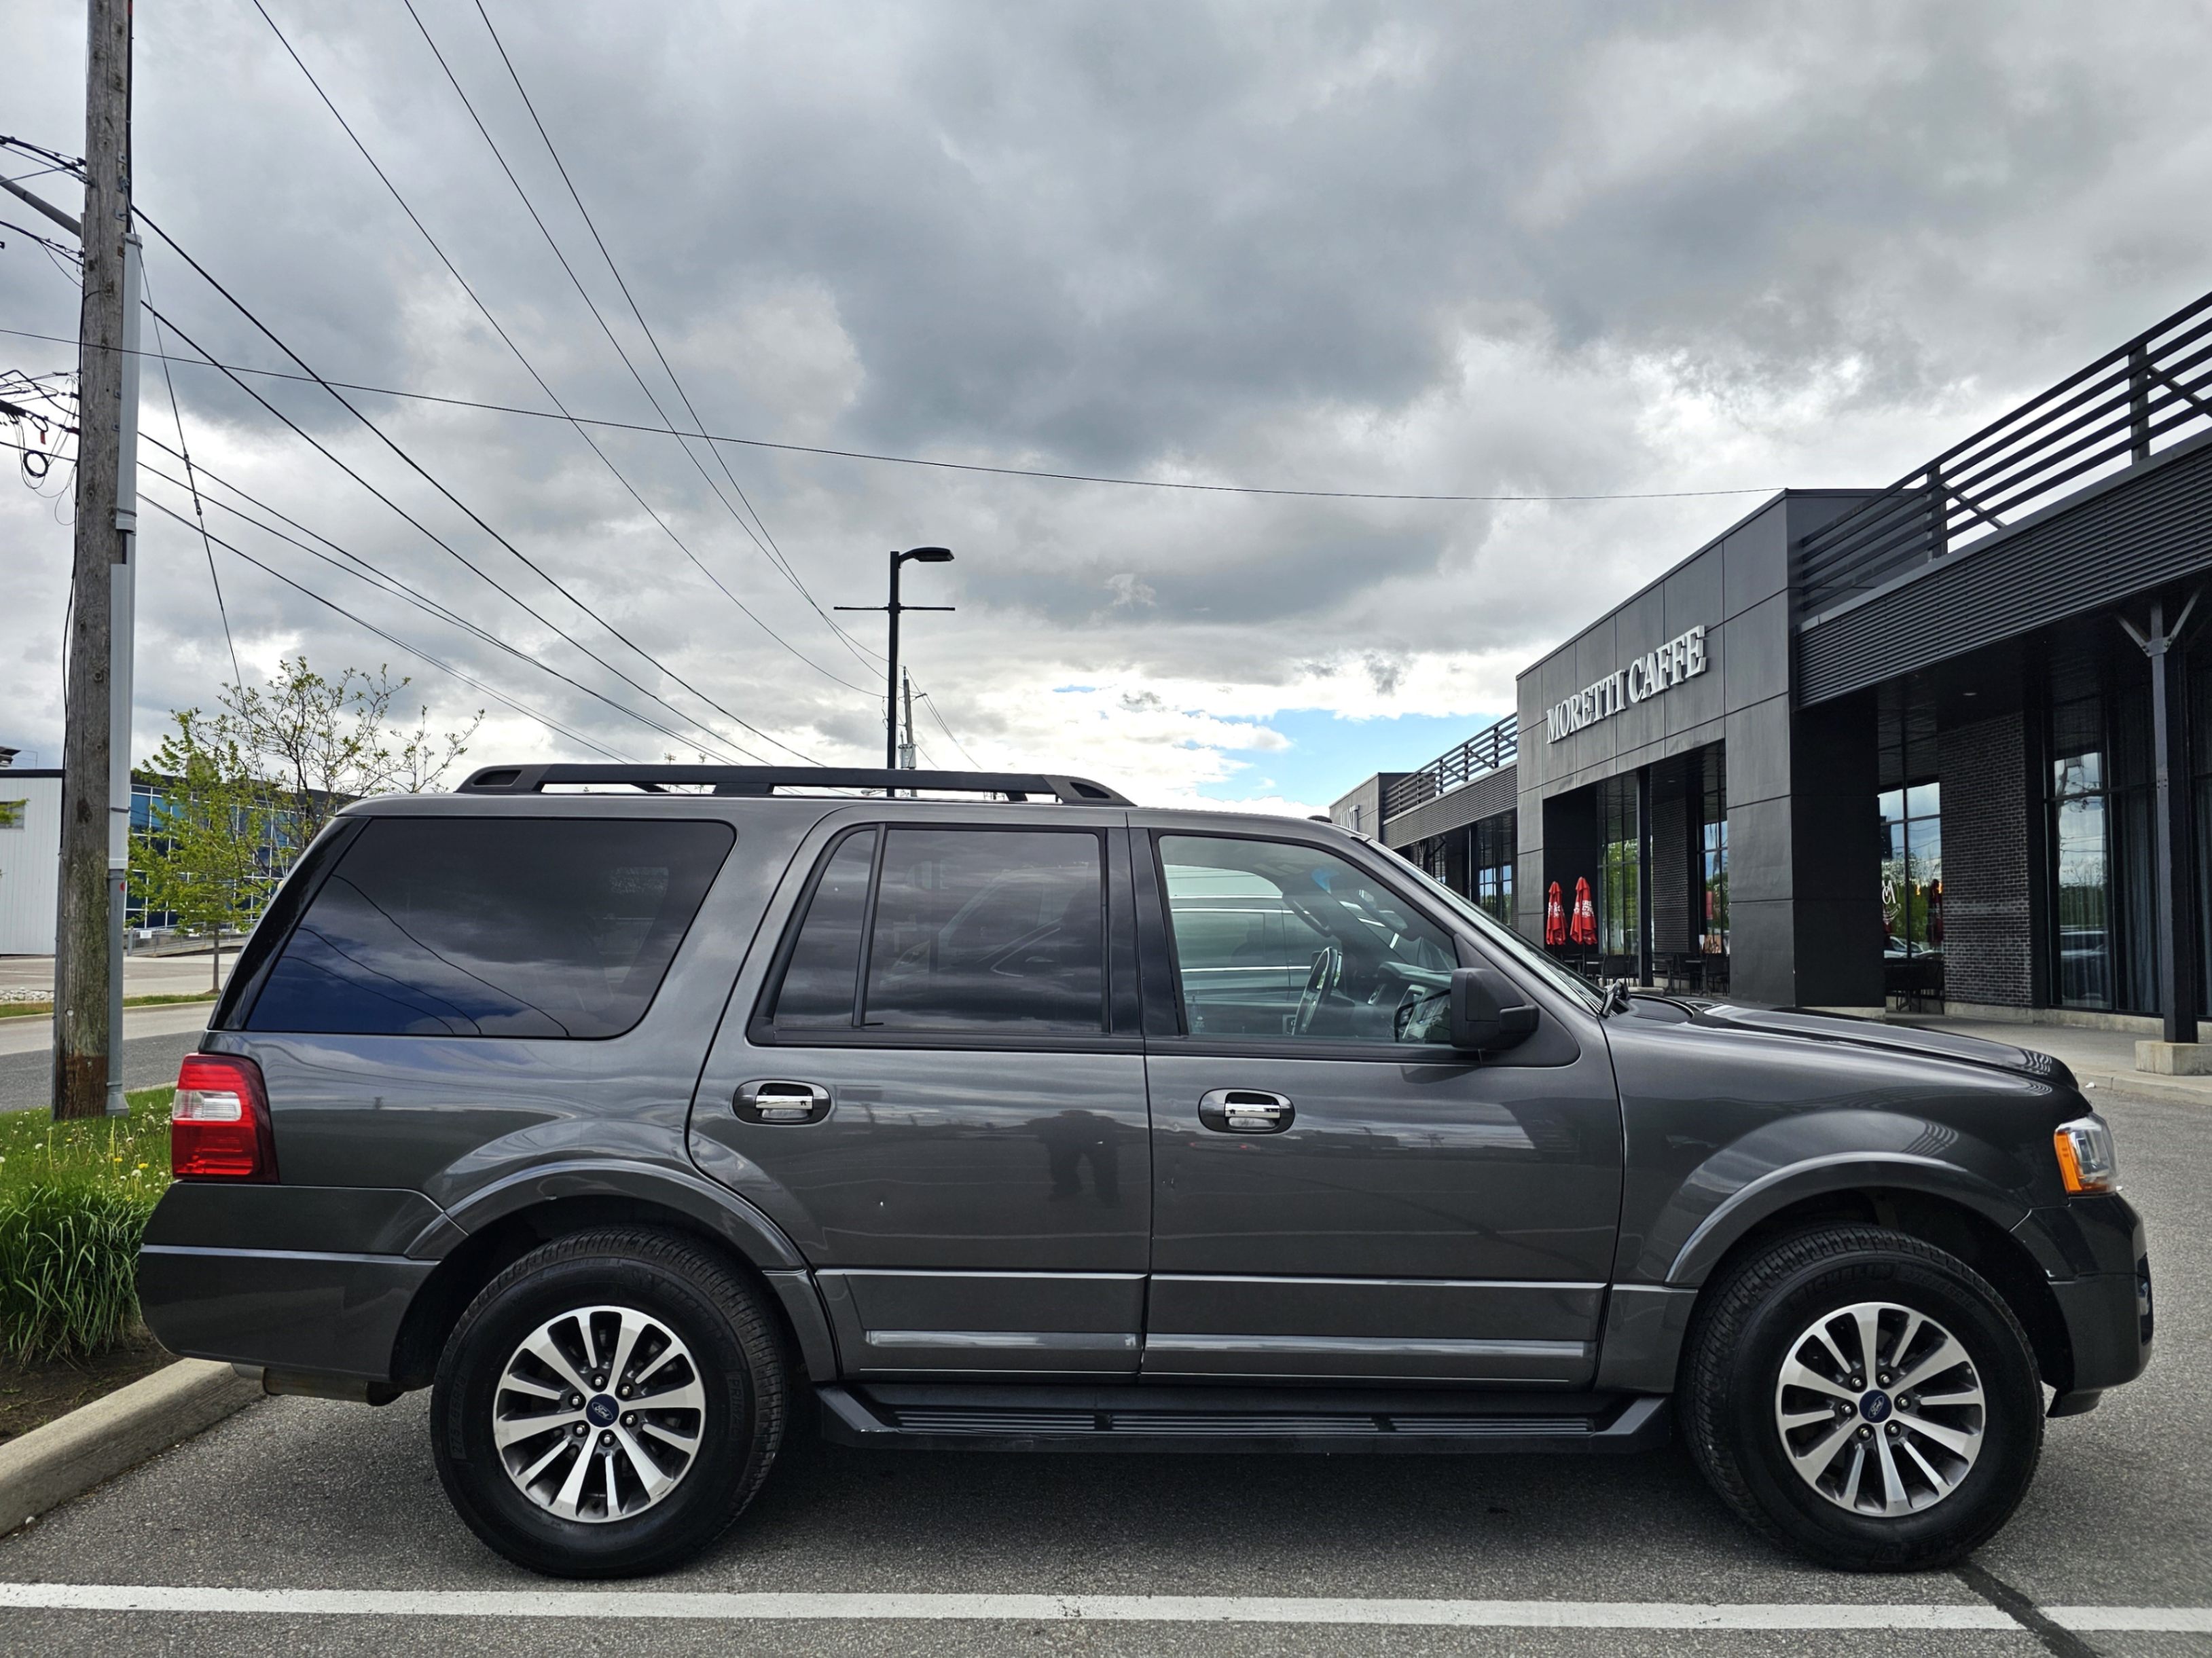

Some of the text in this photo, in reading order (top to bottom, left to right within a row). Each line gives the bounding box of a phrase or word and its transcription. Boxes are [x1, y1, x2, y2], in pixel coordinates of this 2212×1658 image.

[1546, 625, 1707, 744] MORETTI CAFFE
[594, 1404, 611, 1419] Ford
